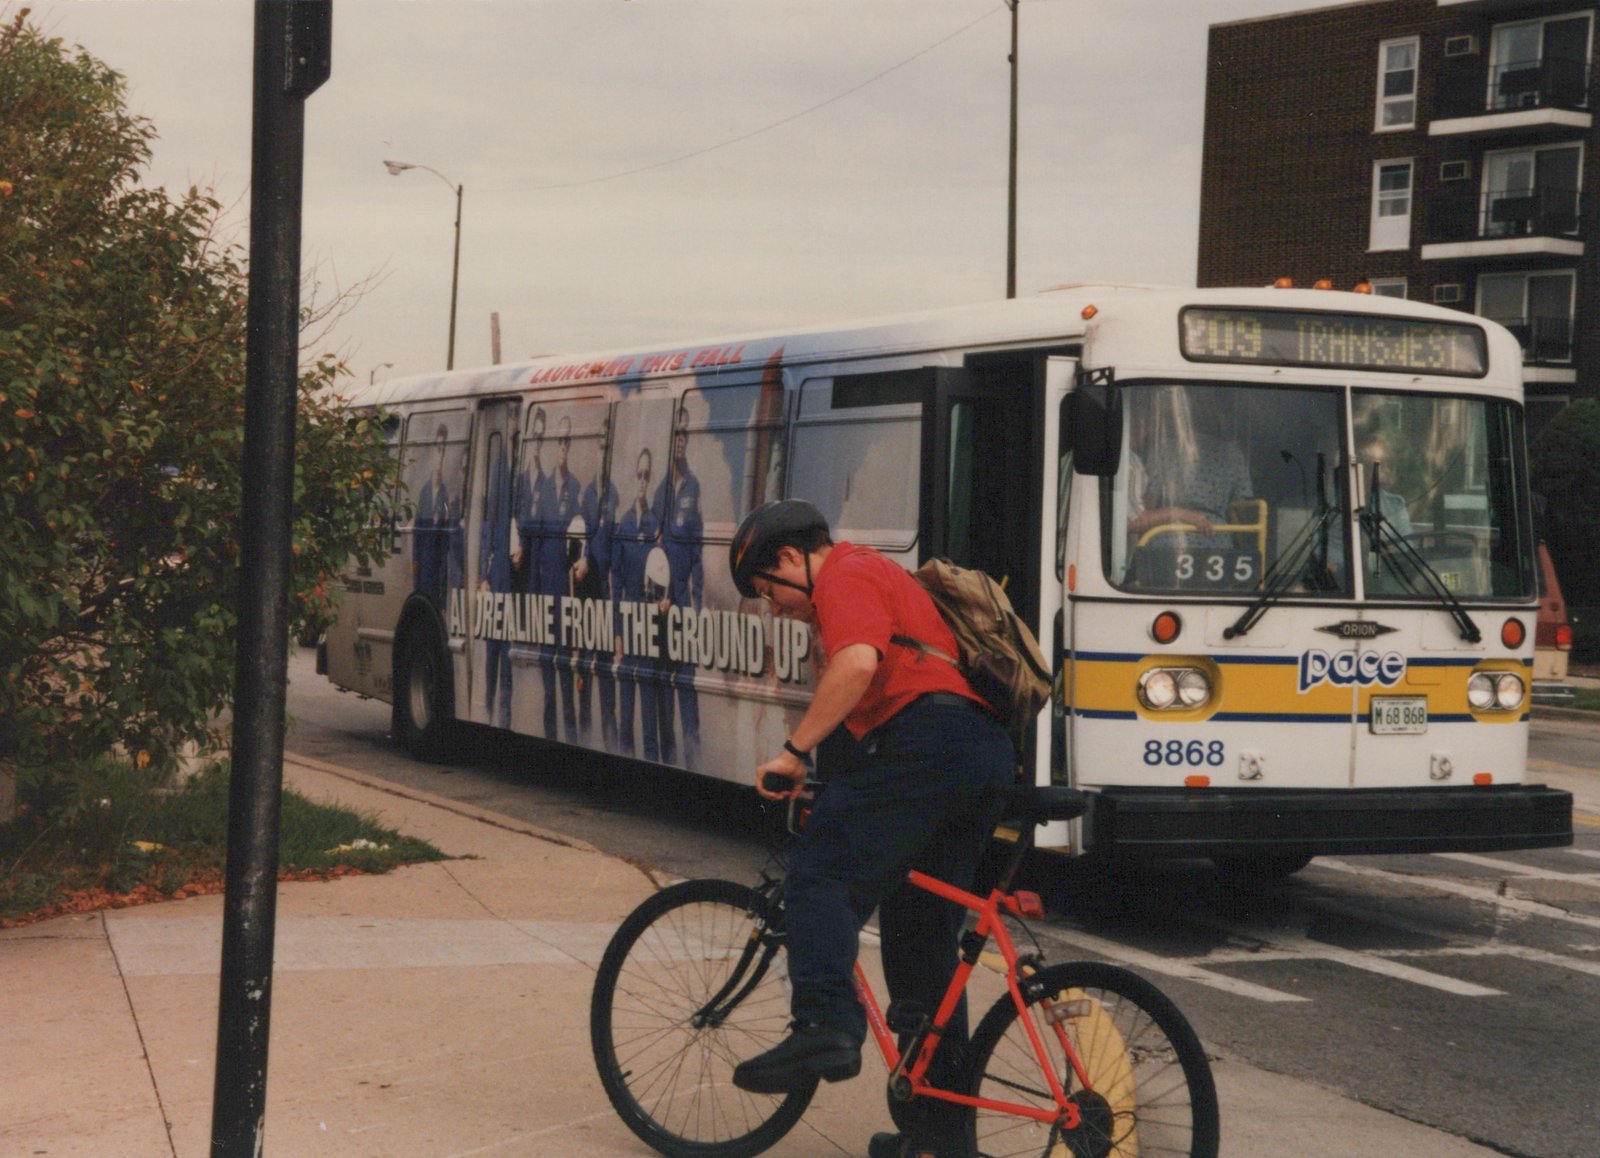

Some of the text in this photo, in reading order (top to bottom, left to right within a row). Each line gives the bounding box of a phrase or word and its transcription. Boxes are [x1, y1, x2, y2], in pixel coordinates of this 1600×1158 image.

[637, 351, 689, 373] THIS
[690, 341, 746, 368] FALL
[560, 596, 615, 652] FROM
[619, 601, 660, 658] THE
[667, 604, 764, 675] GROUND
[773, 617, 809, 681] UP
[1342, 623, 1377, 636] ORION
[1298, 649, 1407, 693] pace
[1403, 706, 1425, 725] 868
[1143, 739, 1225, 767] 8868
